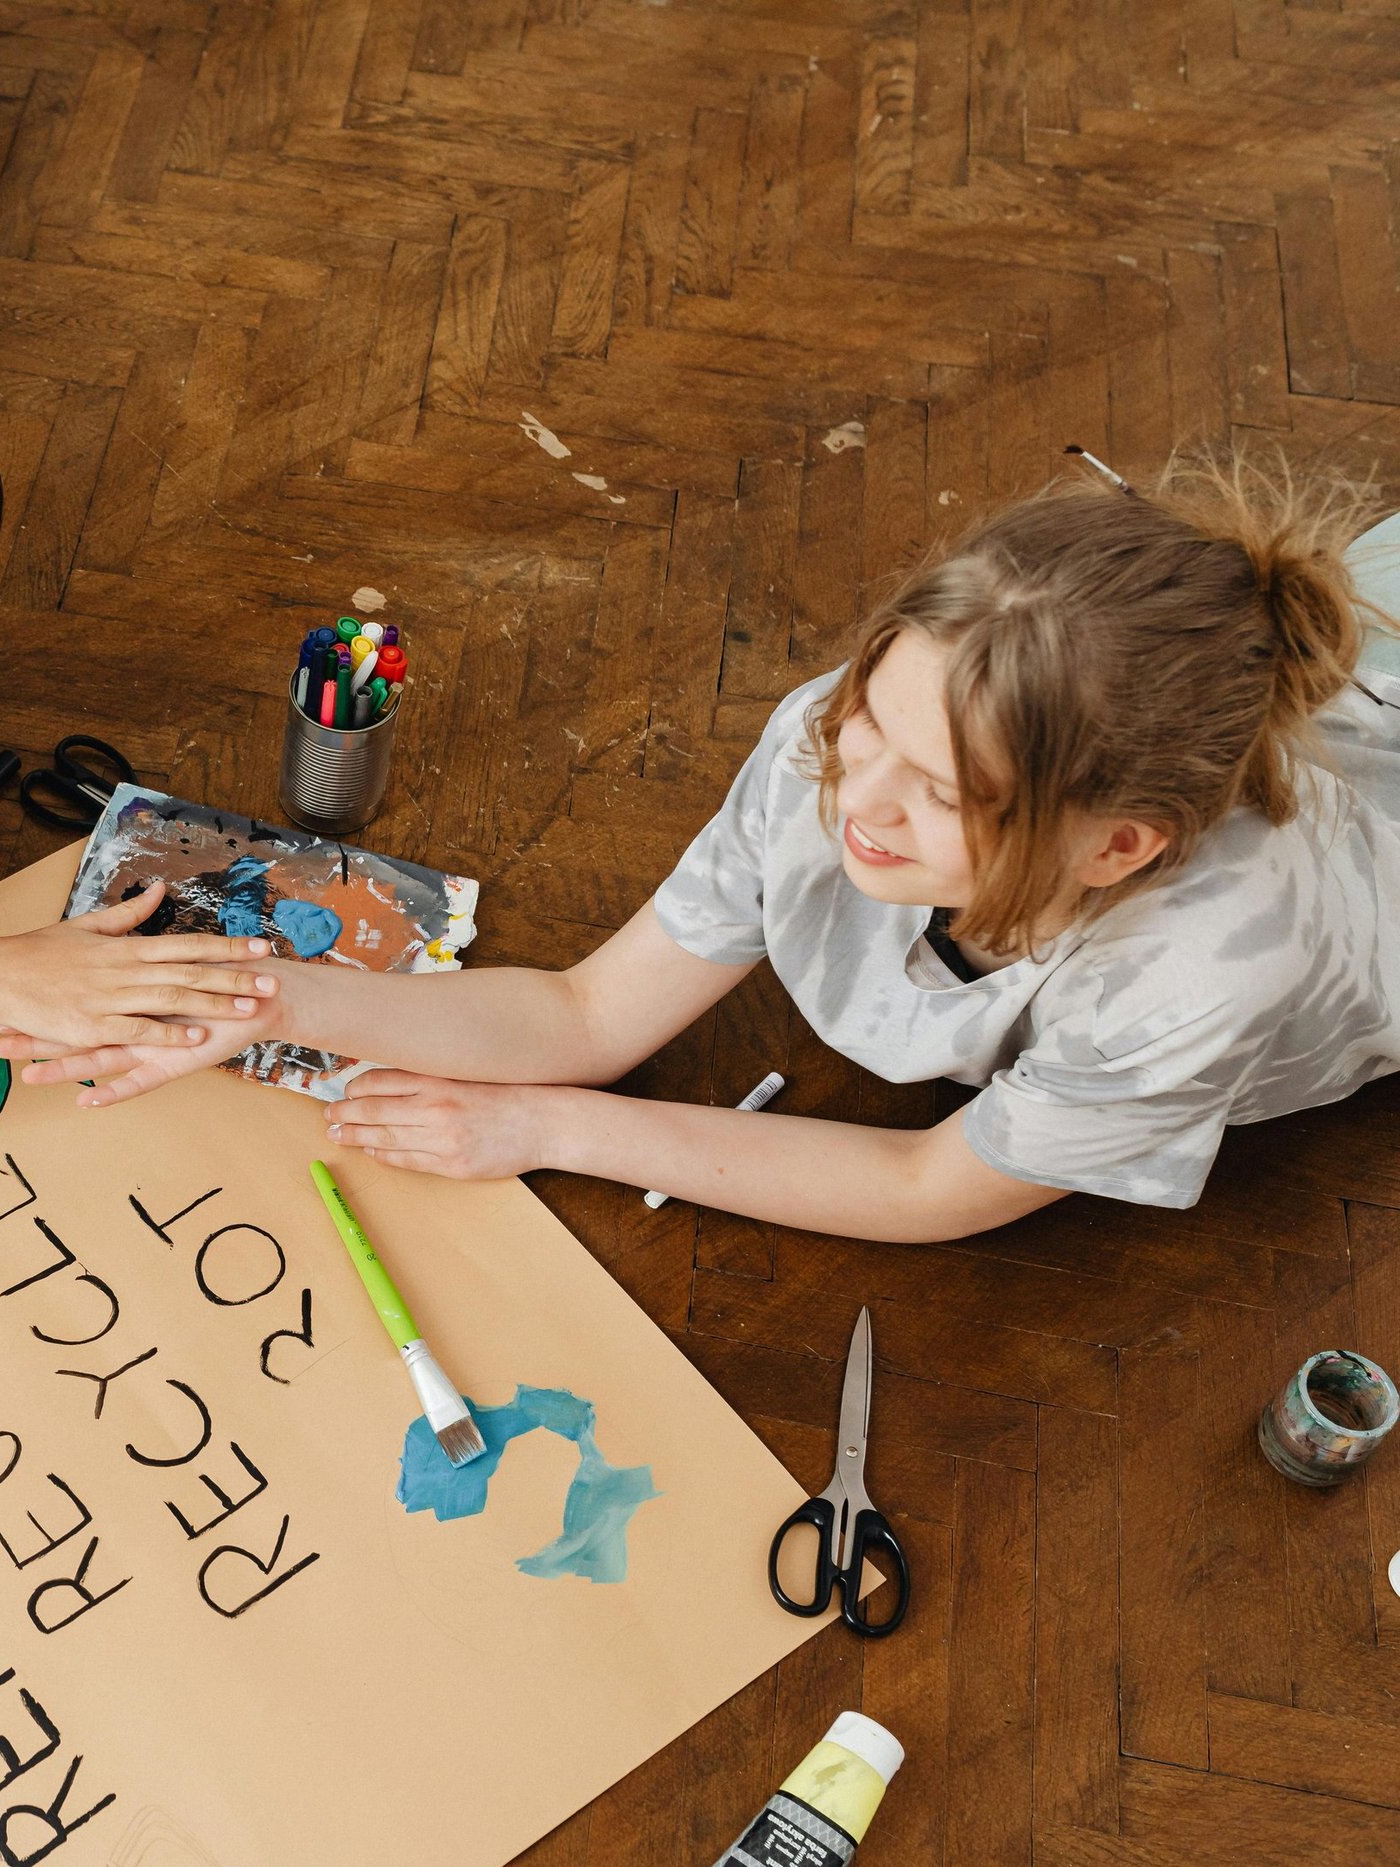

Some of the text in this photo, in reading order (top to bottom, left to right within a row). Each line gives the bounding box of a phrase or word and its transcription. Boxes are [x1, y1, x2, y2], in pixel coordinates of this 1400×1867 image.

[128, 1187, 315, 1385] ROT
[766, 1813, 828, 1859] farba akrylowa
